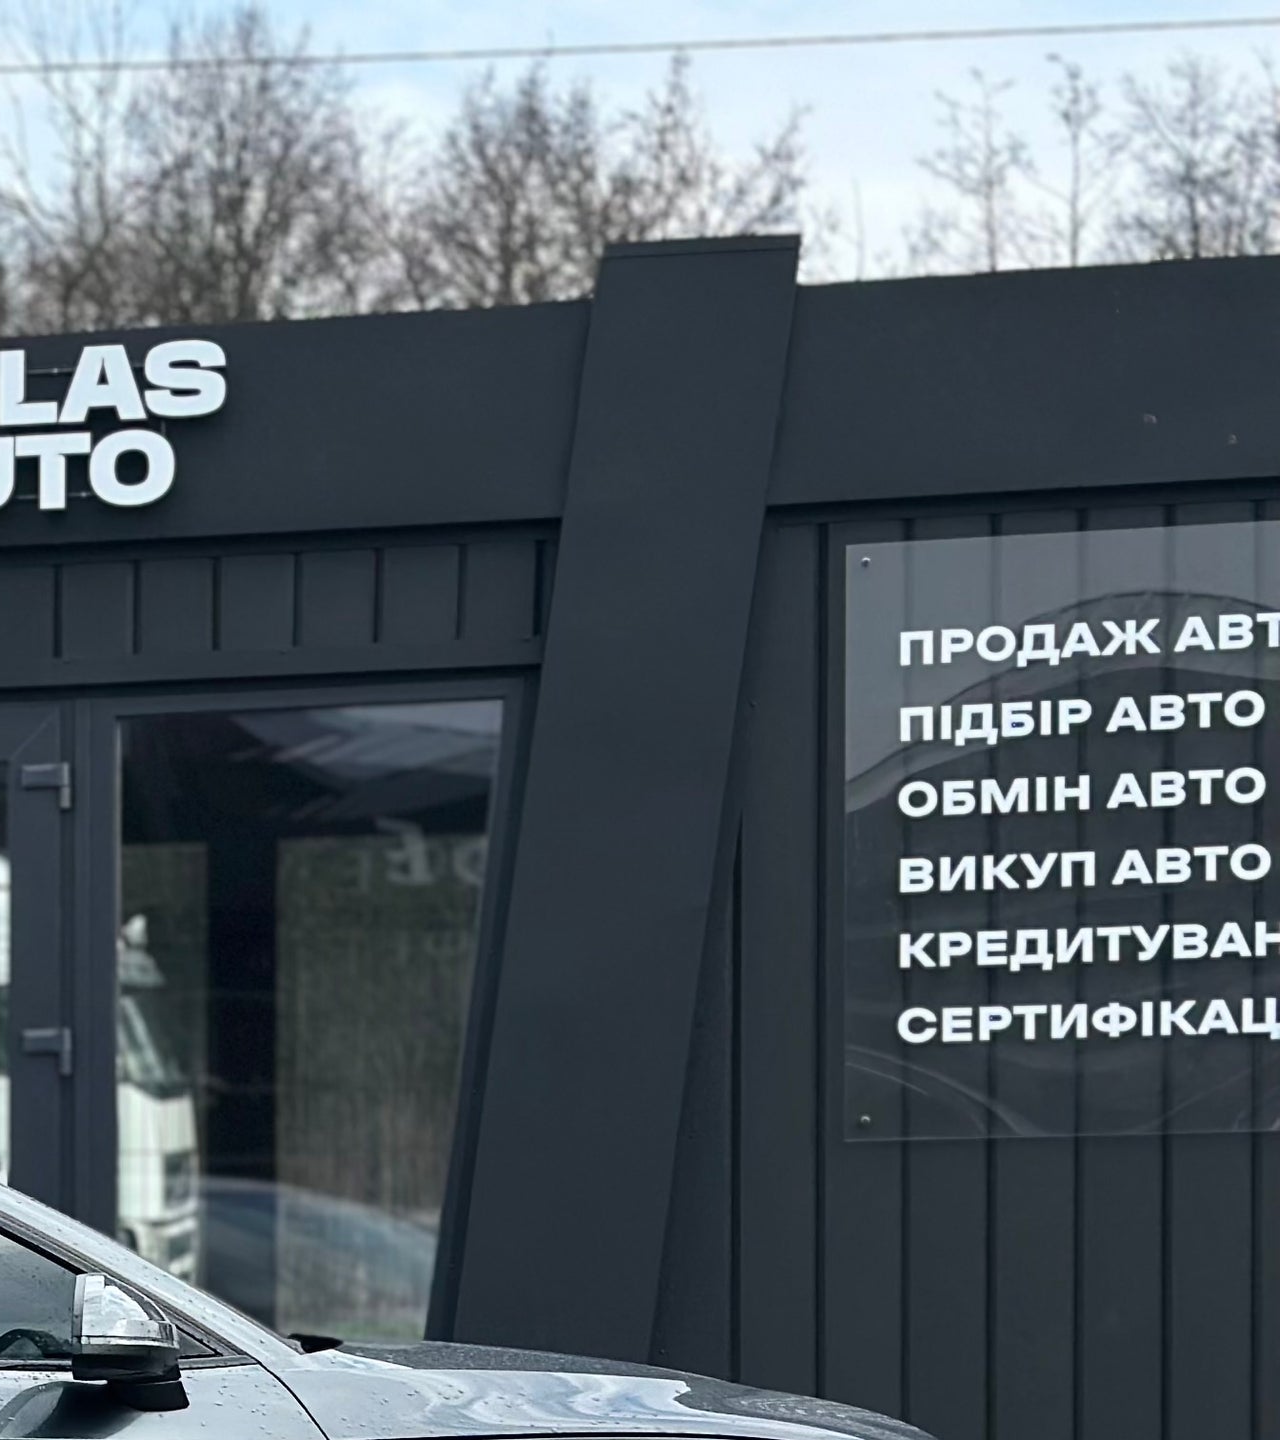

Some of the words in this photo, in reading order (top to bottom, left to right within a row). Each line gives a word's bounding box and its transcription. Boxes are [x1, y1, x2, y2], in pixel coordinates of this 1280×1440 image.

[899, 618, 1161, 668] ПРОДАЖ
[1173, 612, 1280, 653] АВТ
[899, 699, 1092, 746] ПІДБІР
[1106, 690, 1265, 733] АВТО
[898, 774, 1090, 817] ОБМІН
[1106, 767, 1266, 809] АВТО
[899, 851, 1096, 893] ВИКУП
[1111, 843, 1272, 885] АВТО
[897, 997, 1280, 1043] СЕРТИФІКАЦ
